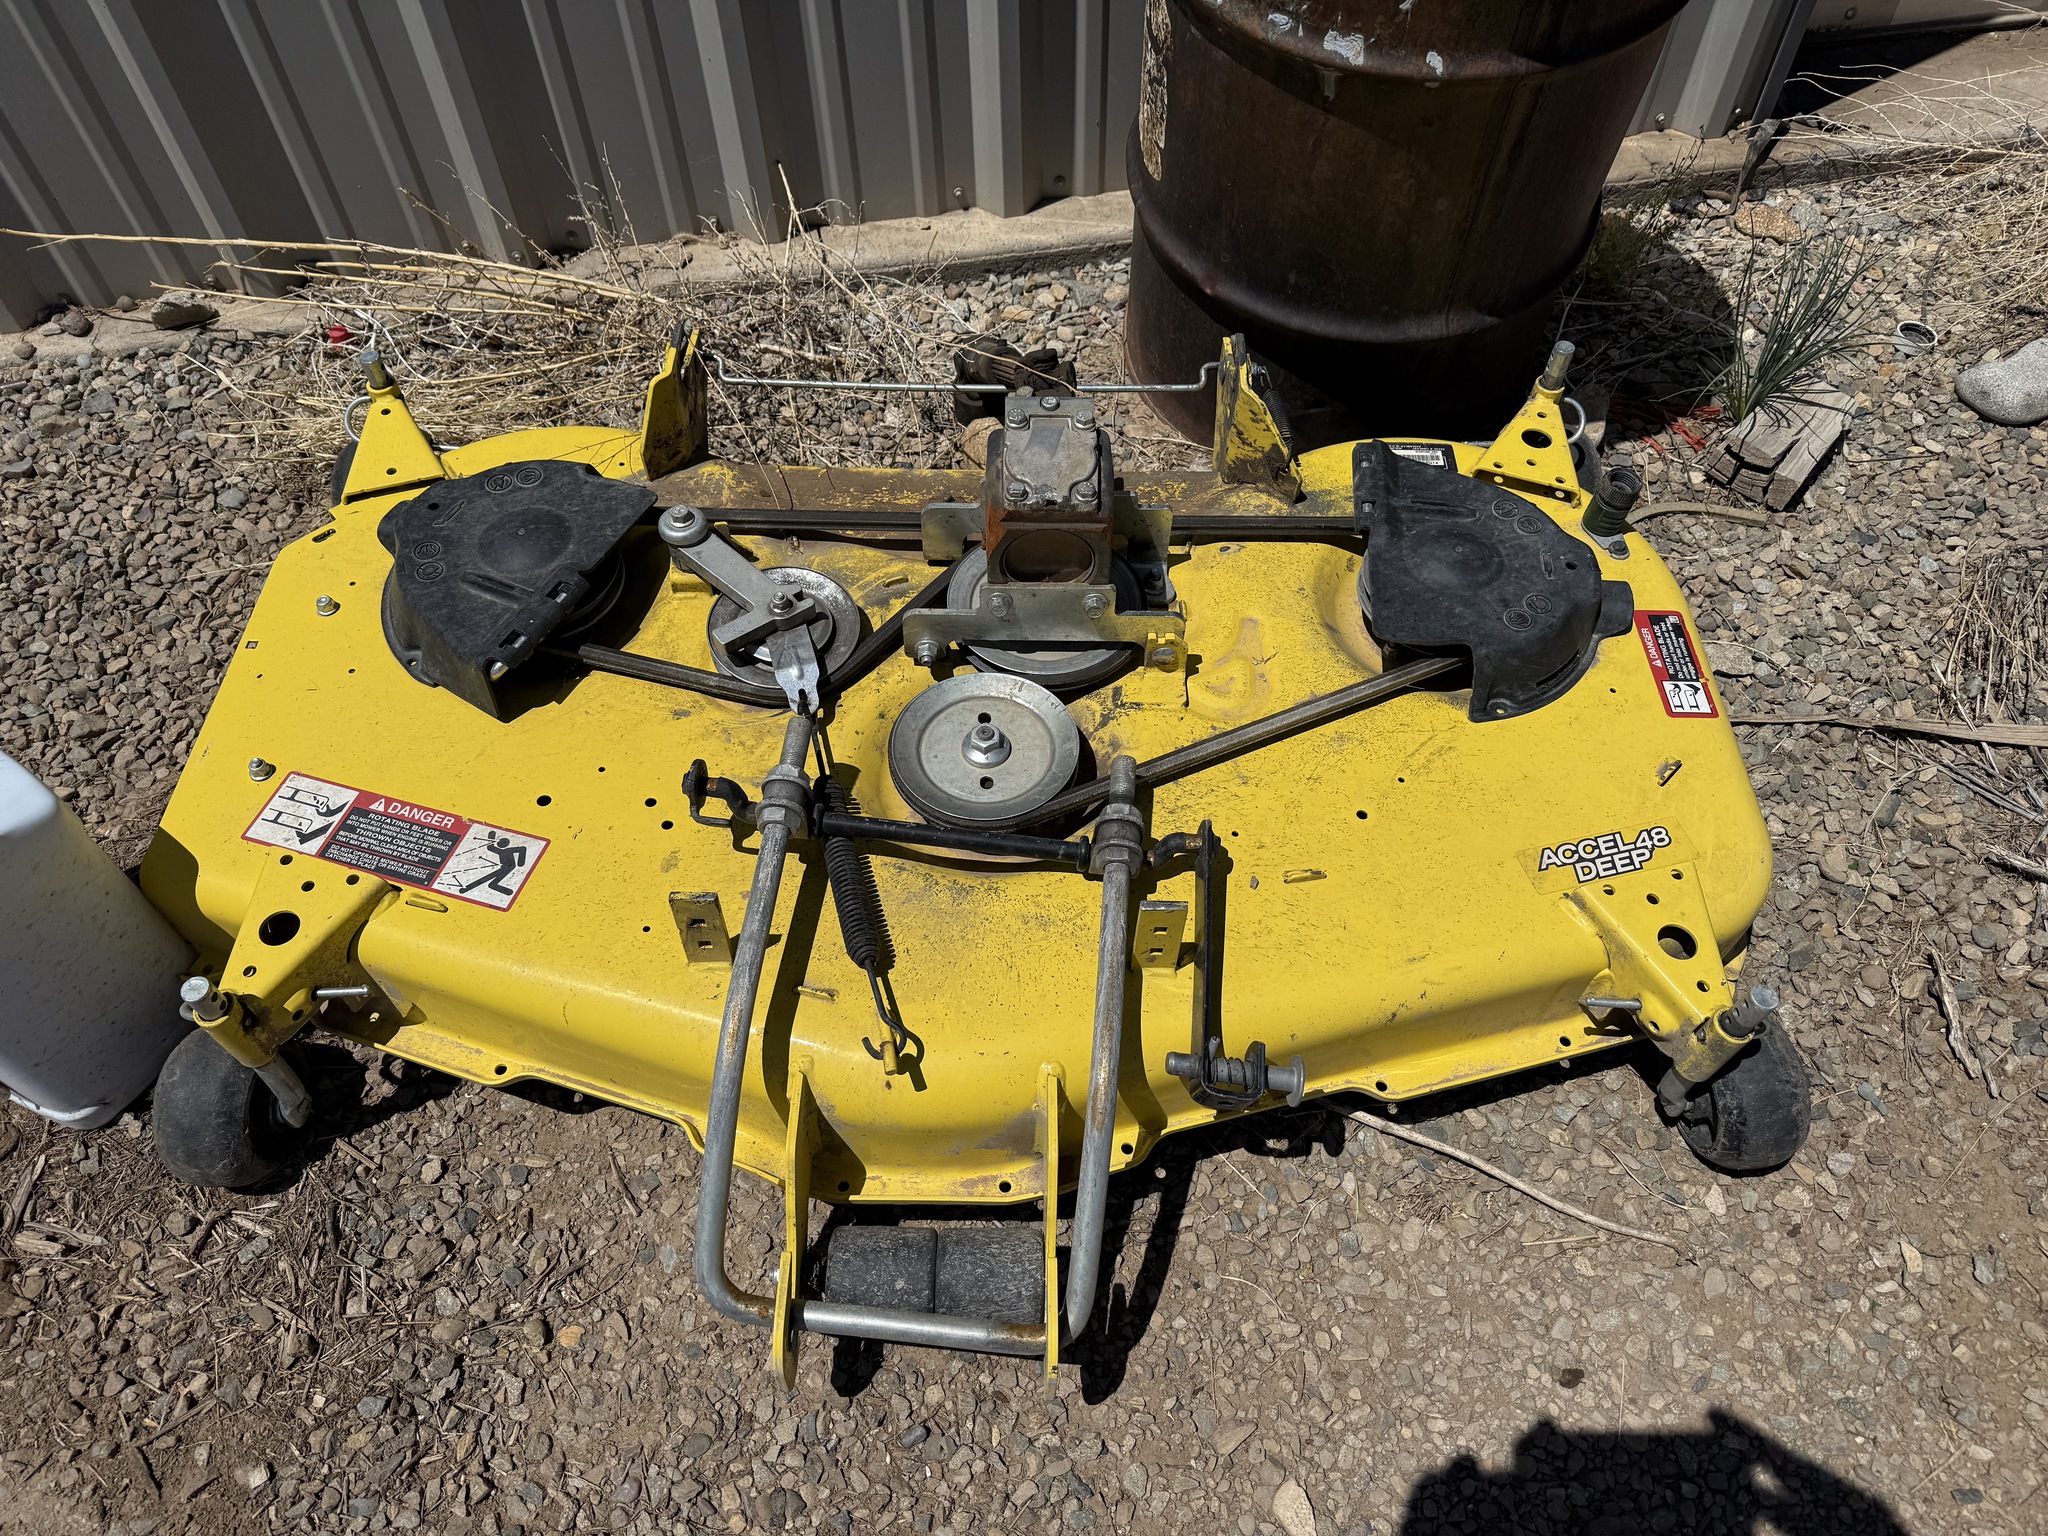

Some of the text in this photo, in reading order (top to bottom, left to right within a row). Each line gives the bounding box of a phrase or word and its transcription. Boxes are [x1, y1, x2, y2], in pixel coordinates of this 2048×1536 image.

[1641, 628, 1658, 658] DANGER
[1653, 624, 1675, 674] ROTATING BLADE
[1678, 637, 1688, 656] running
[368, 813, 440, 836] ROTATING BLADE
[387, 802, 455, 829] DANGER
[338, 831, 359, 840] BEFORE
[379, 842, 398, 850] CLEAR
[397, 847, 411, 855] AREA
[418, 852, 442, 863] OBJECTS
[356, 828, 432, 853] THROWN OBJECTS
[360, 823, 381, 832] MOWER
[380, 829, 397, 837] WHEN
[397, 834, 418, 843] ENGINE
[423, 841, 449, 851] RUNNING
[381, 823, 401, 832] HANDS
[409, 831, 424, 839] FEET
[423, 835, 444, 844] UNDER
[325, 853, 351, 864] CATCHER
[357, 861, 376, 870] PLACE
[335, 835, 350, 843] THAT
[369, 845, 393, 855] THROWN
[401, 853, 420, 862] BLADE
[327, 848, 360, 861] DISCHARGE
[359, 857, 379, 866] CHUTE
[386, 864, 407, 874] ENTIRE
[406, 869, 427, 879] GRASS
[353, 850, 380, 861] OPERATE
[380, 857, 403, 867] MOWER
[403, 864, 430, 875] WITHOUT
[1573, 848, 1653, 884] DEEP
